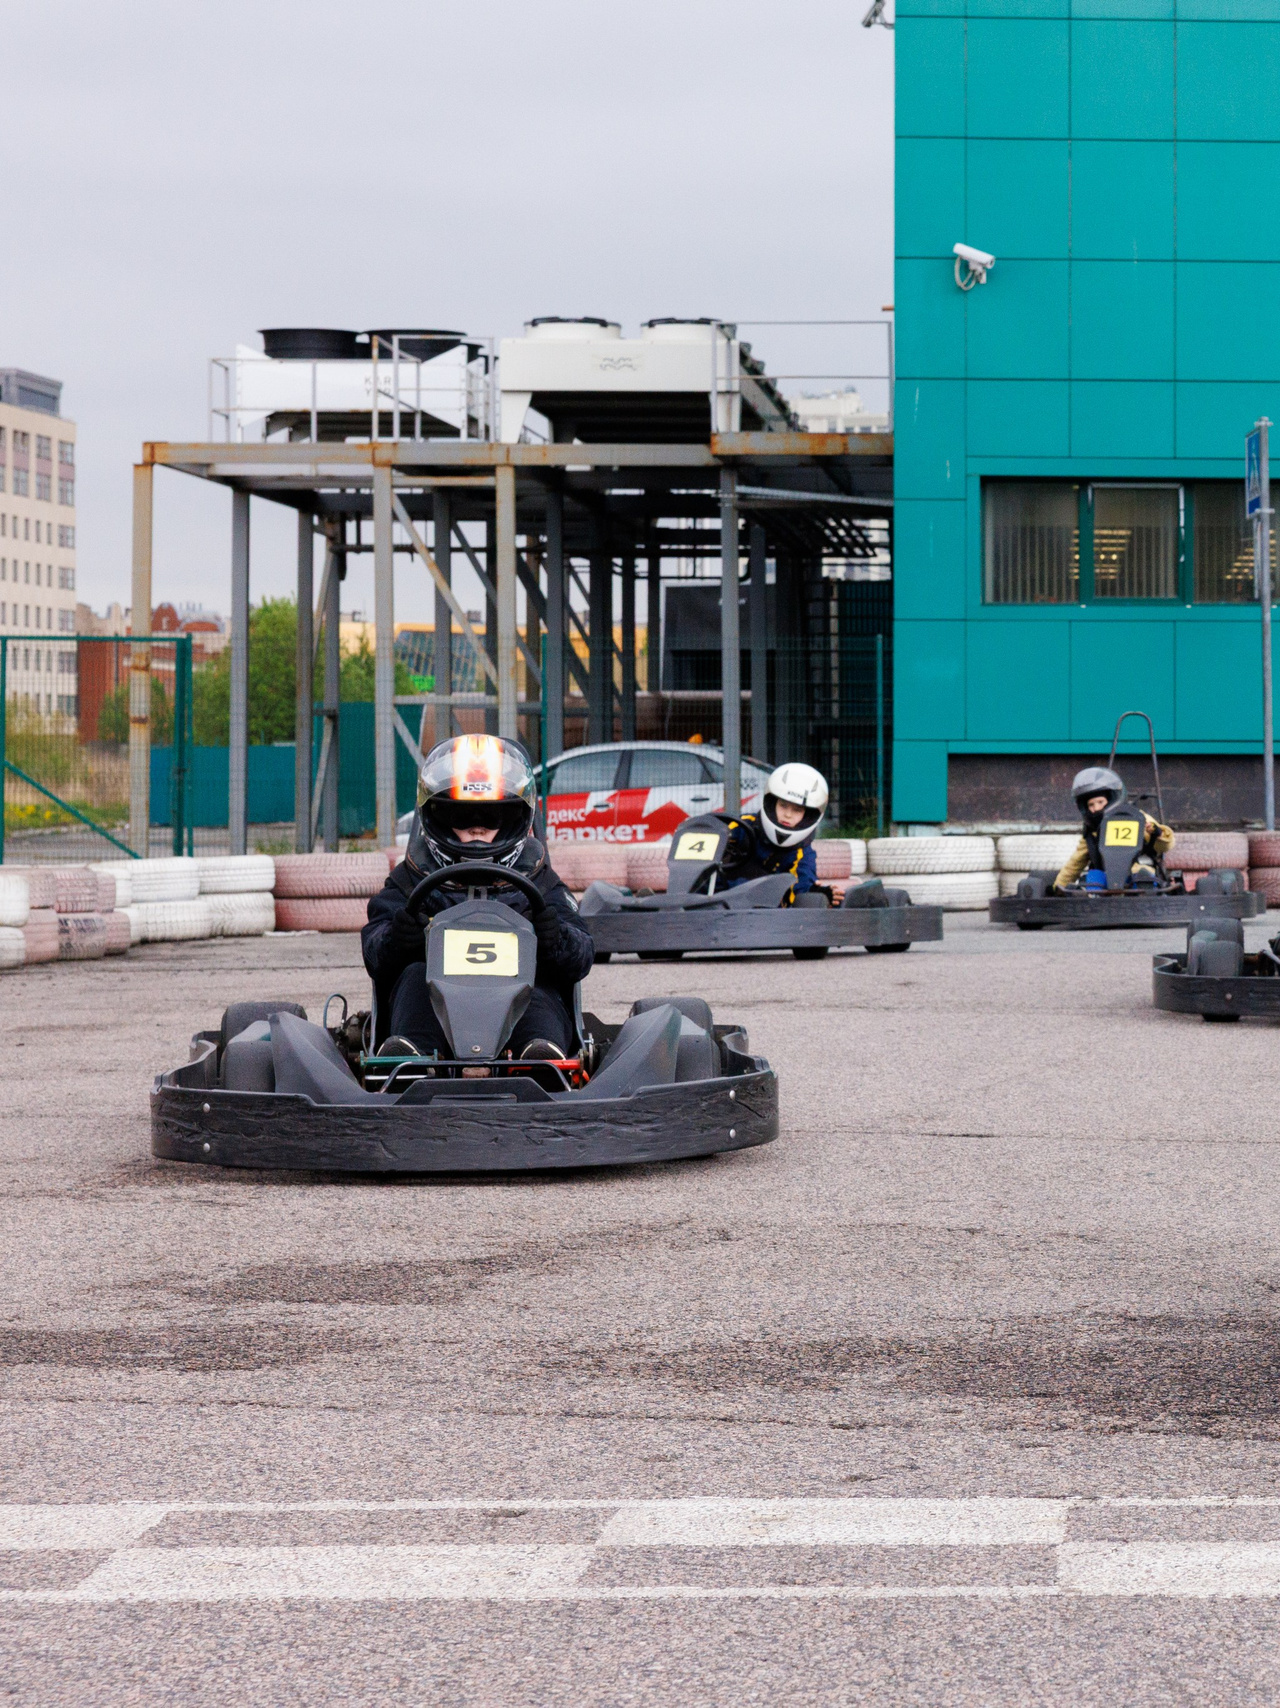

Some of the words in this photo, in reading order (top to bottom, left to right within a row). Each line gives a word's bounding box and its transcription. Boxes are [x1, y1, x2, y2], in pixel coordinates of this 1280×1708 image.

[546, 807, 586, 825] декс
[1114, 827, 1132, 840] 12
[688, 841, 706, 853] 4
[465, 943, 498, 965] 5
